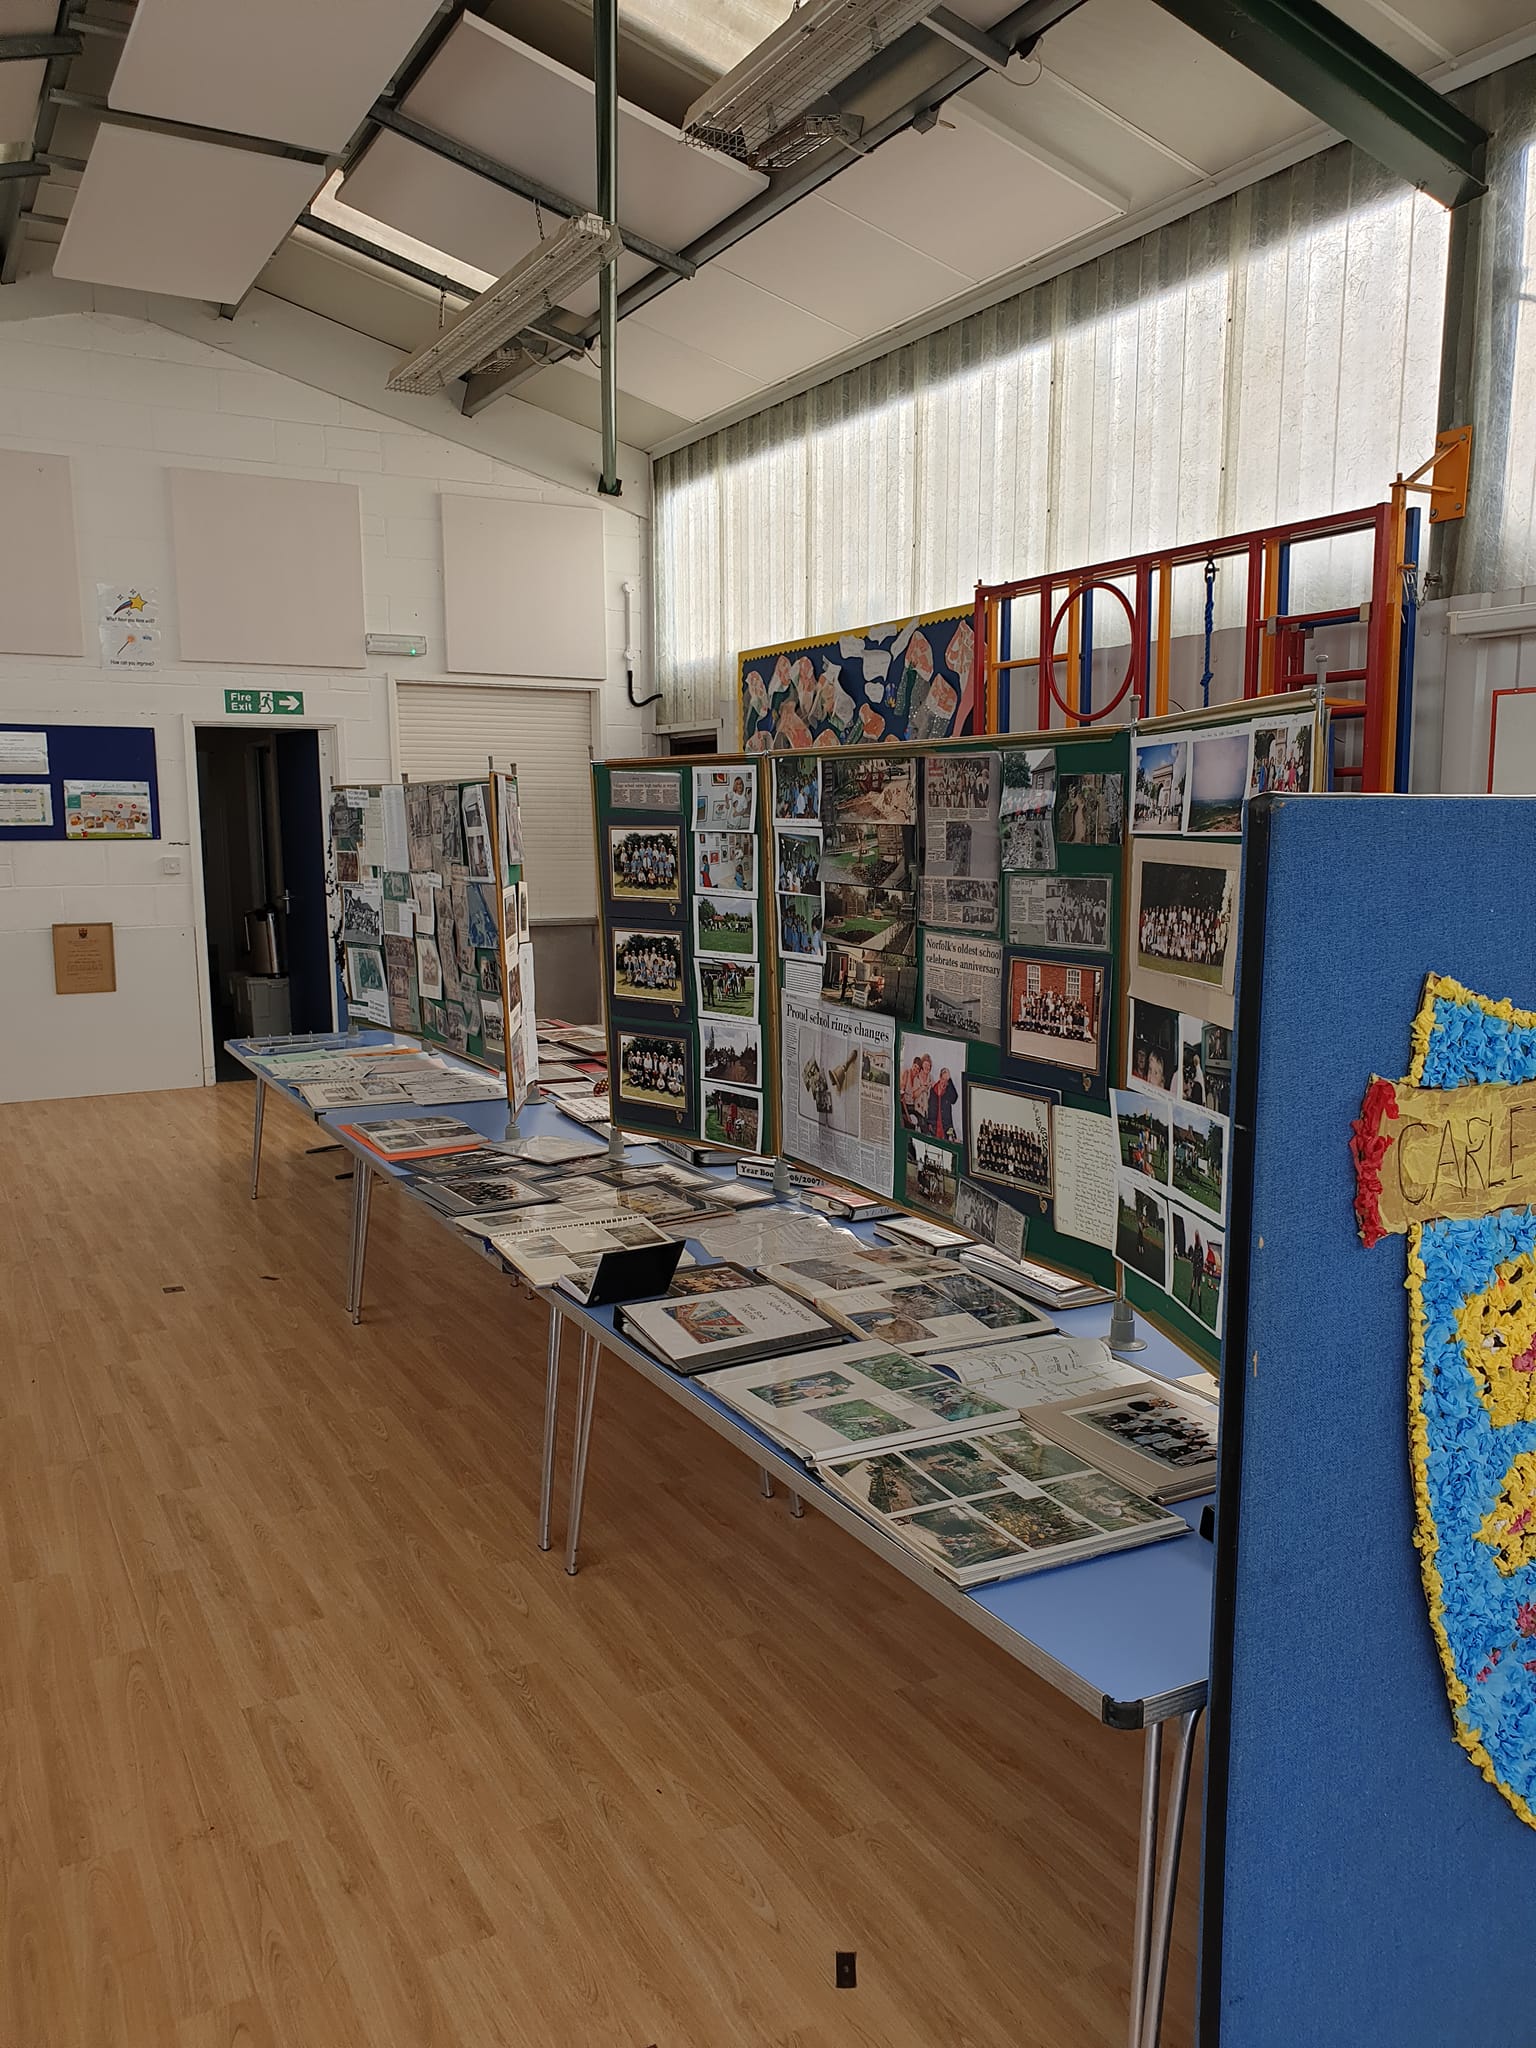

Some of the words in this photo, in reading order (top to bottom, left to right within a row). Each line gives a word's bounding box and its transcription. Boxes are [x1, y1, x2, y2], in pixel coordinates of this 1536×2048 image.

[230, 692, 252, 702] Fire
[231, 702, 252, 711] Exit
[926, 938, 956, 952] Norfolk's
[956, 941, 978, 956] oldest
[979, 946, 1002, 960] school
[925, 954, 959, 967] celebrates
[959, 960, 1001, 978] anniversary
[786, 1003, 808, 1022] Proud
[809, 1011, 829, 1028] school
[829, 1016, 853, 1035] rings
[854, 1021, 890, 1042] changes
[1397, 1106, 1536, 1205] CARLE
[740, 1165, 759, 1176] Year
[760, 1168, 774, 1178] Boo
[789, 1174, 820, 1185] 06/2007
